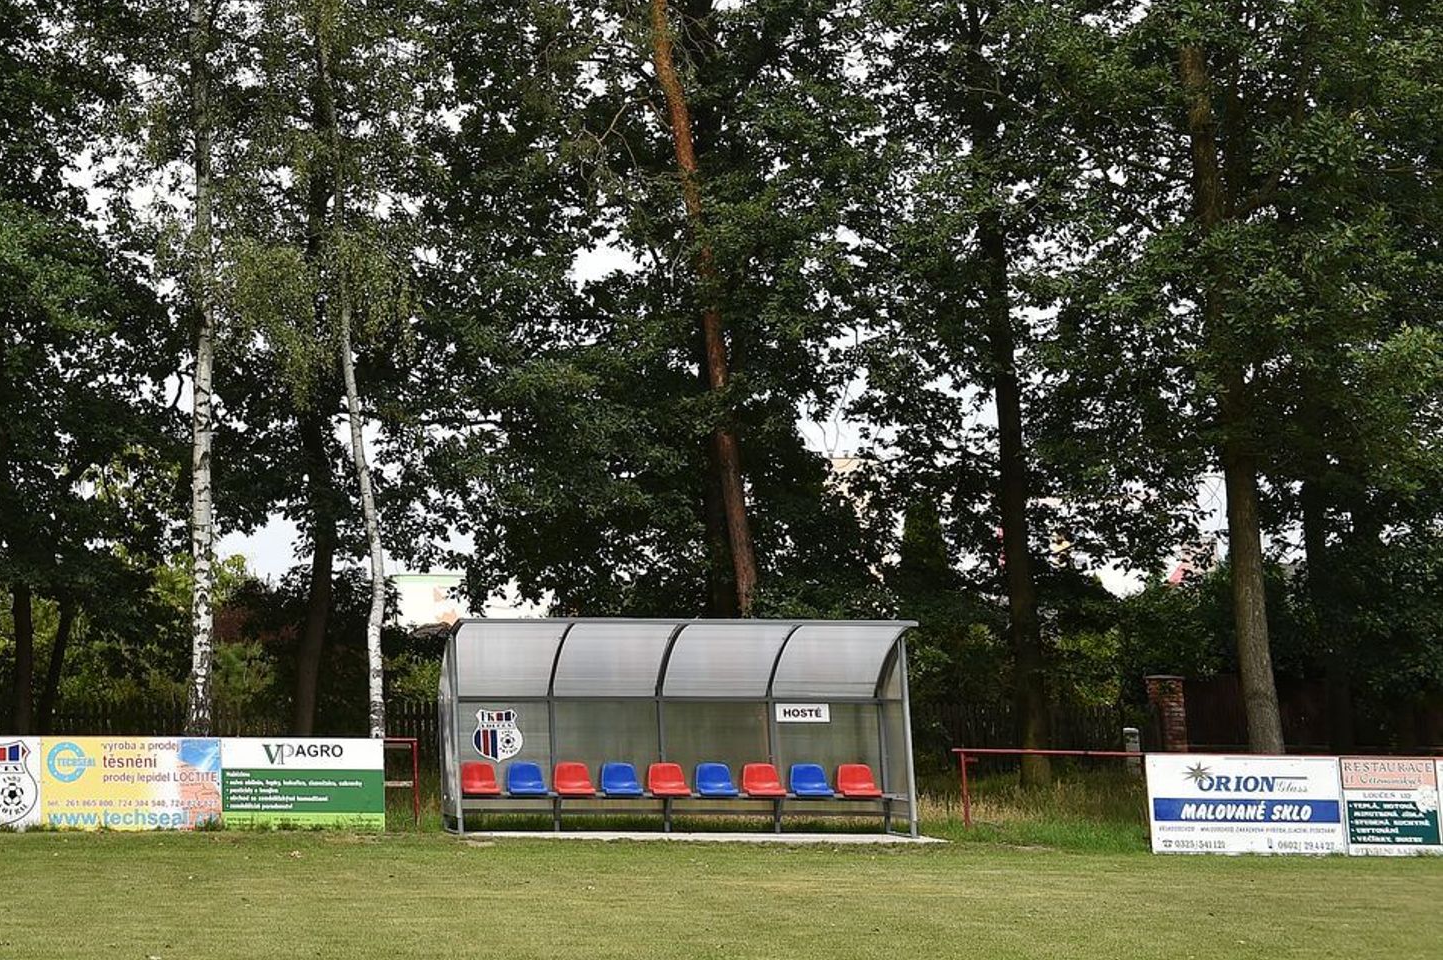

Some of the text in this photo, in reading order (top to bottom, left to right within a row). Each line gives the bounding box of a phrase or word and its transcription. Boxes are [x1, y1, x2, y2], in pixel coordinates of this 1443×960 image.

[783, 706, 822, 718] HOSTÉ
[148, 741, 179, 752] prodej
[262, 743, 344, 765] VP AGRO
[103, 753, 157, 768] těsnění
[1344, 762, 1433, 773] RESTAURACE
[103, 772, 217, 783] prodej lepidel LOCTITE
[1198, 775, 1276, 792] ORION
[170, 799, 185, 807] 724
[1181, 801, 1313, 821] MALOVANÉ SKLO
